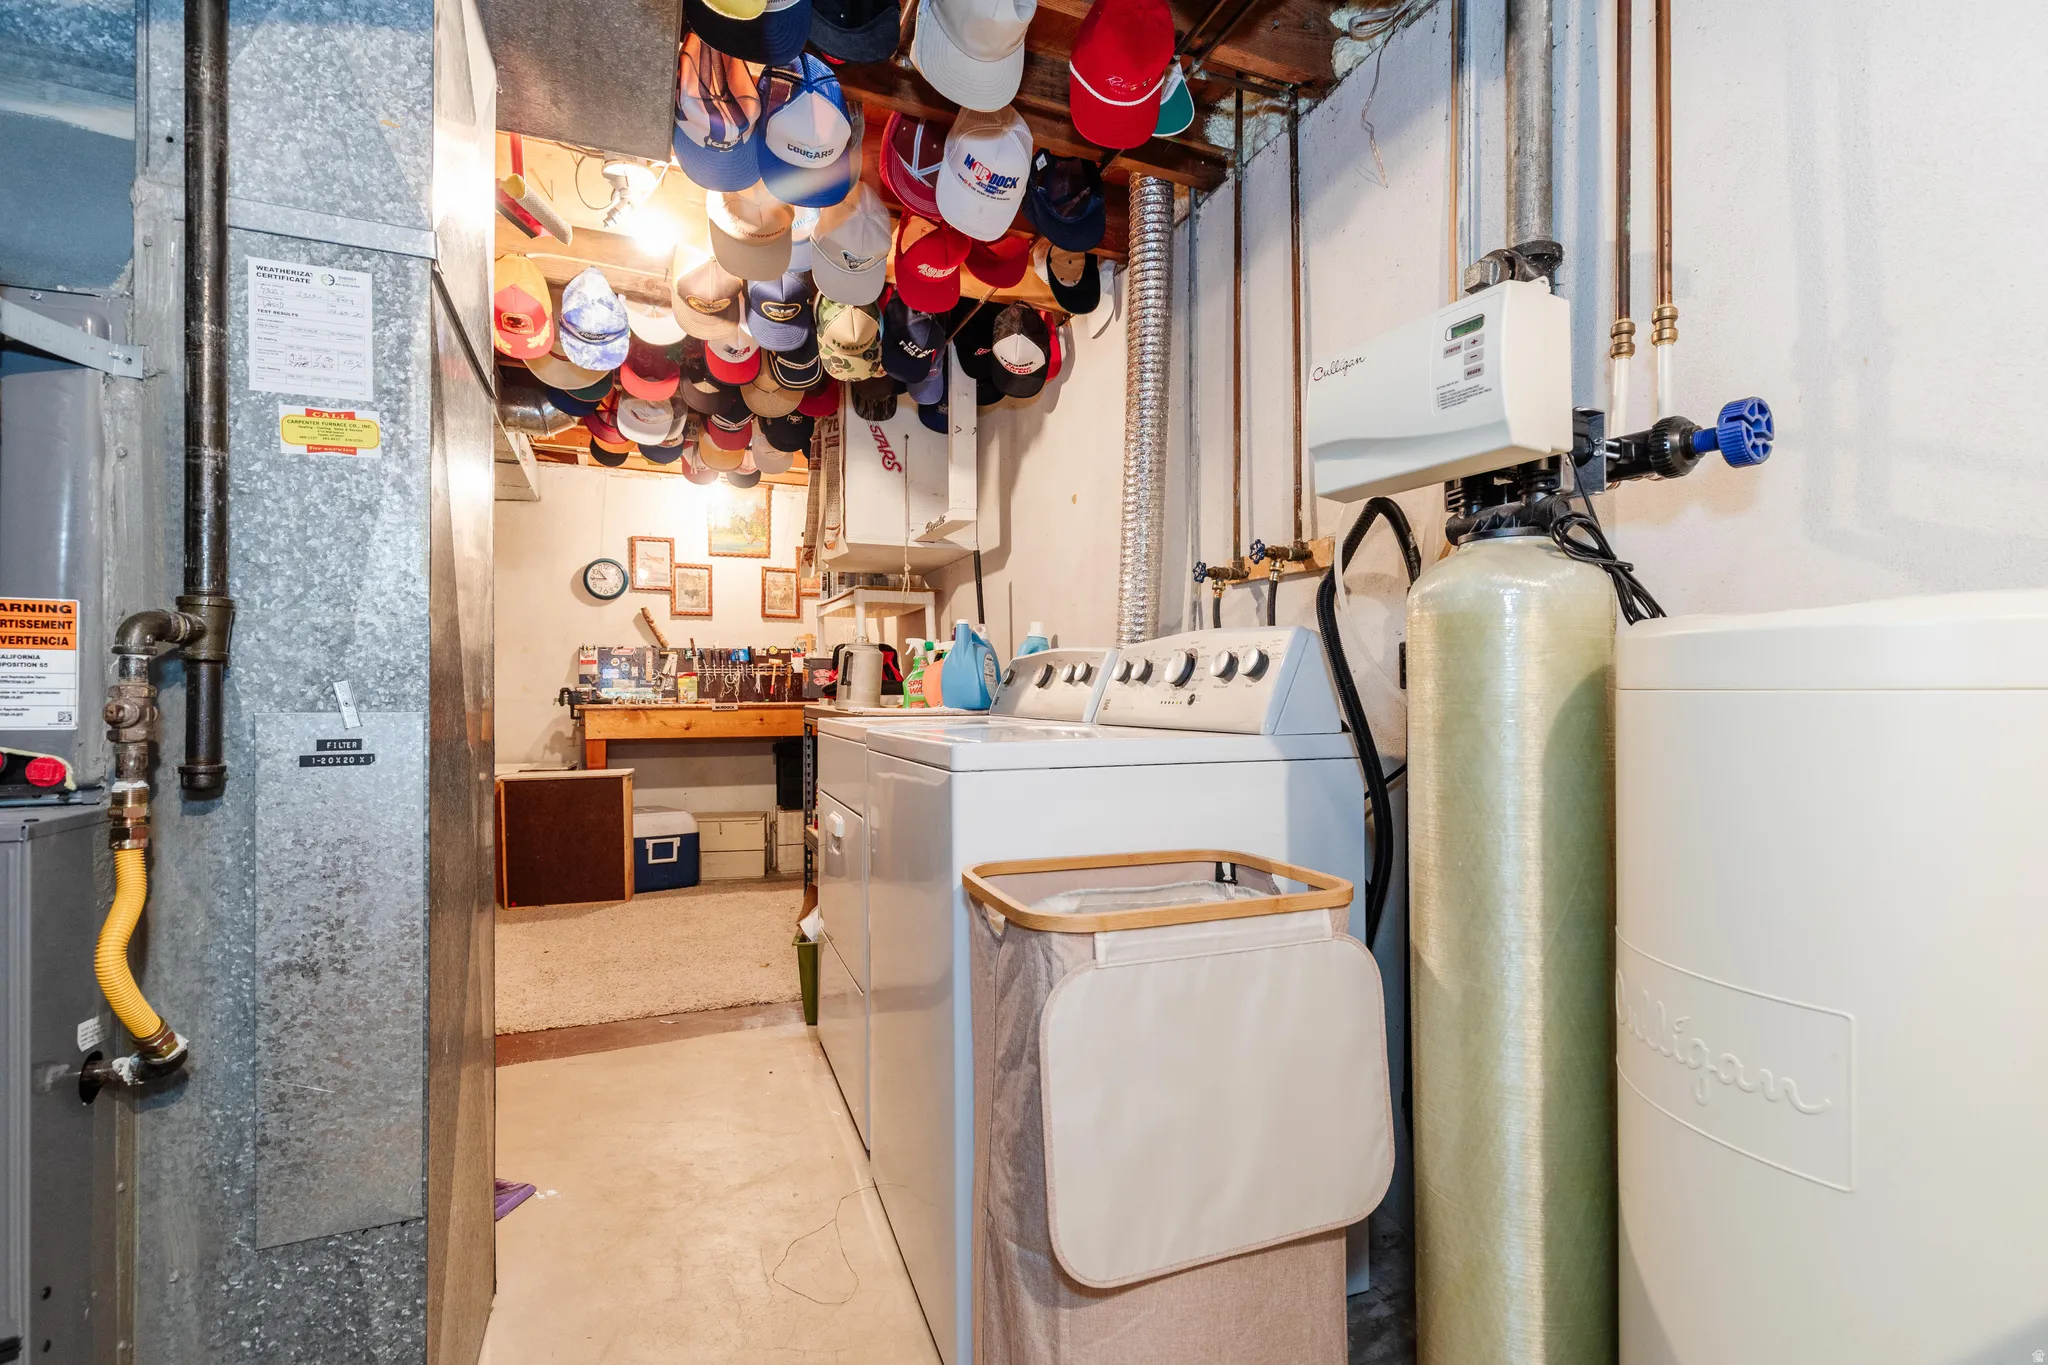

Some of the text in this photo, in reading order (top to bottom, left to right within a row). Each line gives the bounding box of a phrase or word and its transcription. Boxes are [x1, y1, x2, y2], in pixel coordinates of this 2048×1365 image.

[788, 143, 835, 159] COUGARS
[963, 153, 1020, 188] MURDOCK
[256, 272, 311, 284] CERTIFICATE
[1312, 355, 1366, 381] Culligan
[312, 412, 349, 420] CALL
[869, 424, 903, 474] STARS
[0, 603, 72, 614] ARNING
[0, 619, 73, 630] RTISSEMENT
[0, 635, 69, 646] VERTENCIA
[326, 741, 358, 749] FILTER
